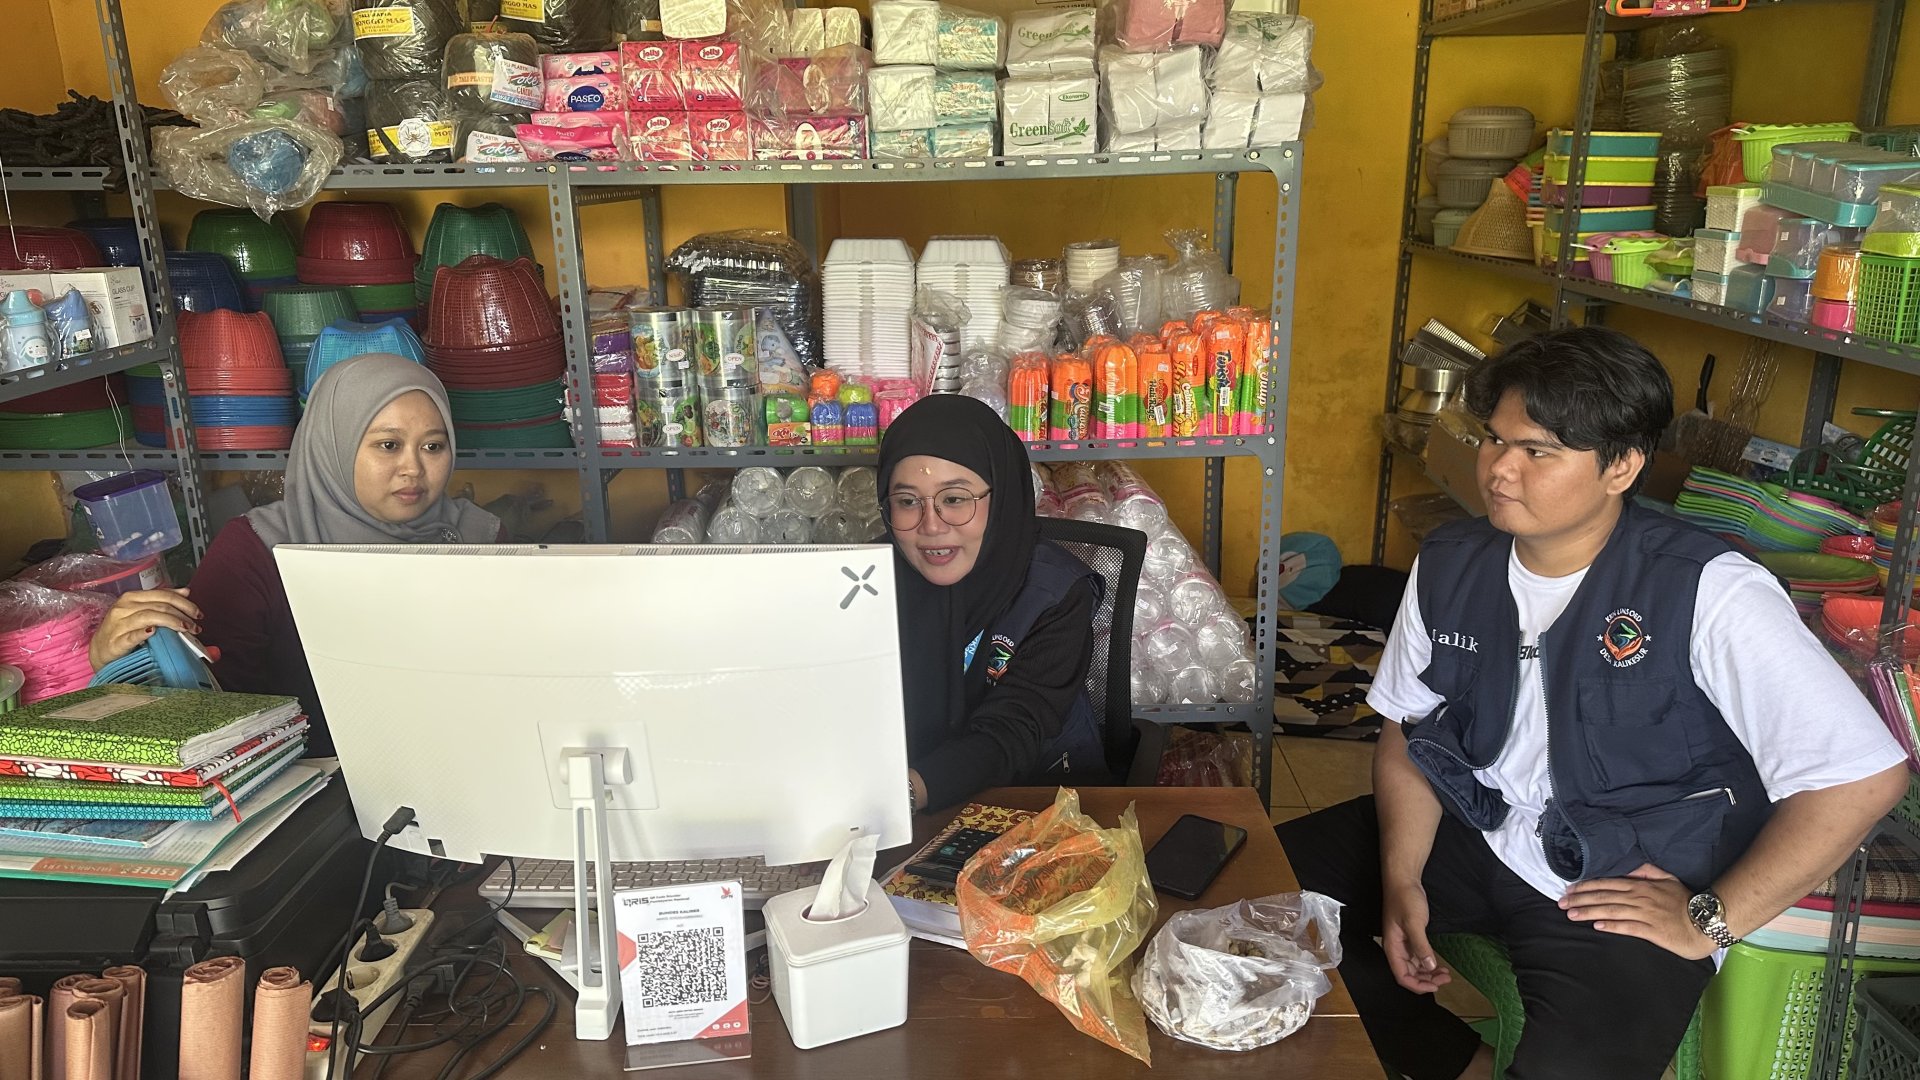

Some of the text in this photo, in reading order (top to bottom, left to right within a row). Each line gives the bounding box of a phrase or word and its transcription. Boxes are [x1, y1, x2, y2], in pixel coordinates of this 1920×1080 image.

[642, 48, 660, 58] jolly
[702, 47, 721, 57] jolly
[570, 94, 601, 103] PASEO
[486, 141, 513, 156] oke
[111, 286, 126, 295] GLASS
[1216, 349, 1232, 394] Twist
[623, 896, 650, 907] QRIS
